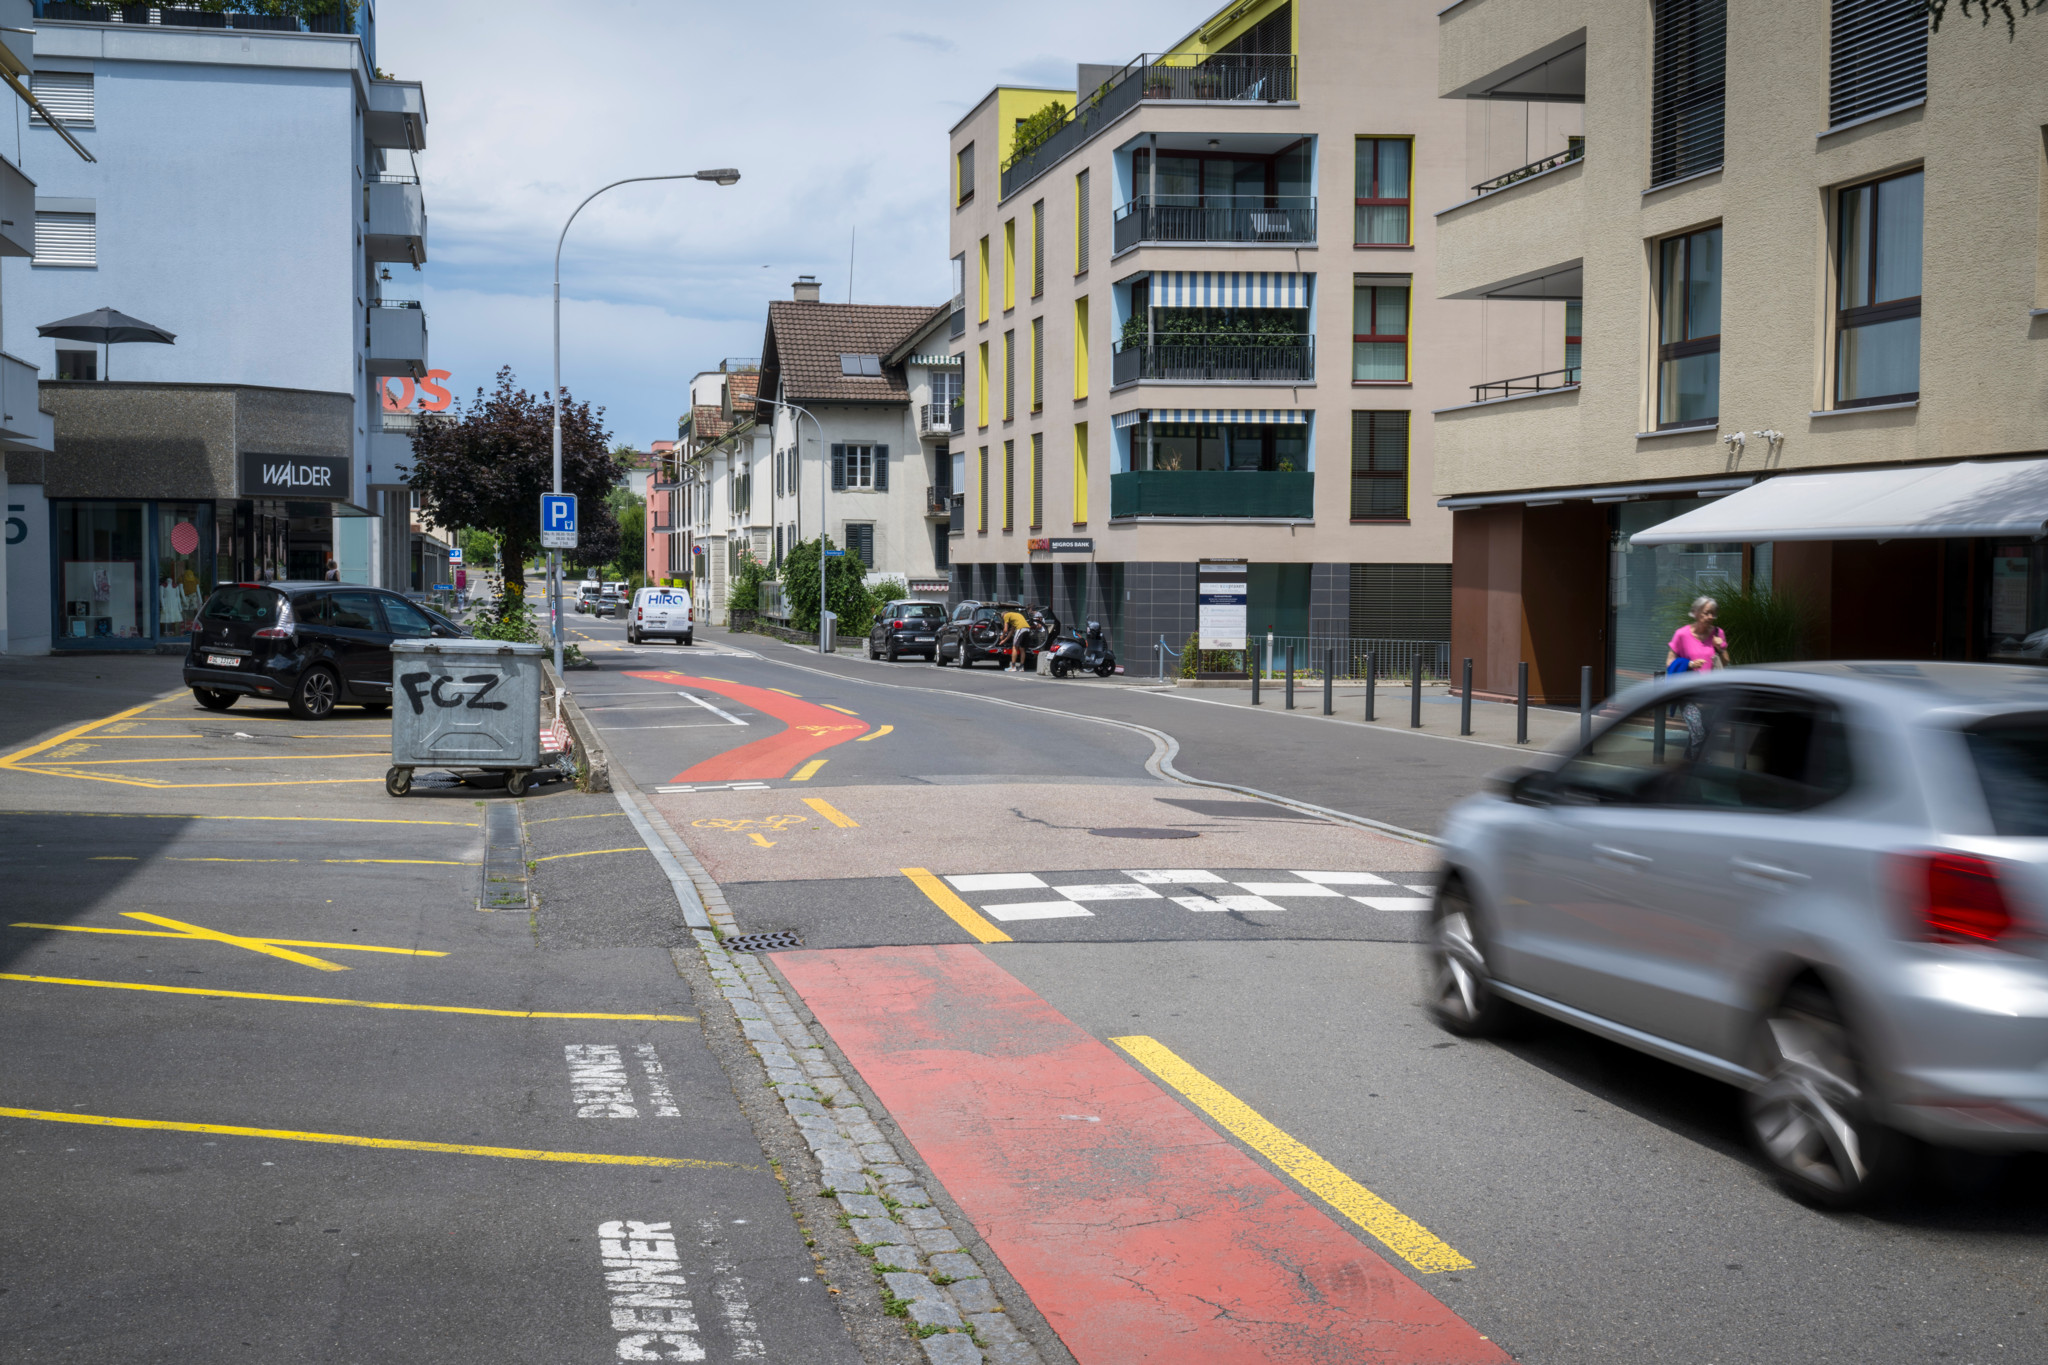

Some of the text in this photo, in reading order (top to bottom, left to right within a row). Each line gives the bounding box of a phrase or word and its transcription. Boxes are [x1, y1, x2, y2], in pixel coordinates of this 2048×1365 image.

[263, 460, 331, 488] WALDER
[552, 501, 567, 527] P
[1052, 541, 1073, 549] MIGROS
[648, 595, 683, 605] HIRO
[400, 672, 508, 715] FCZ
[598, 1220, 706, 1362] DENNER
